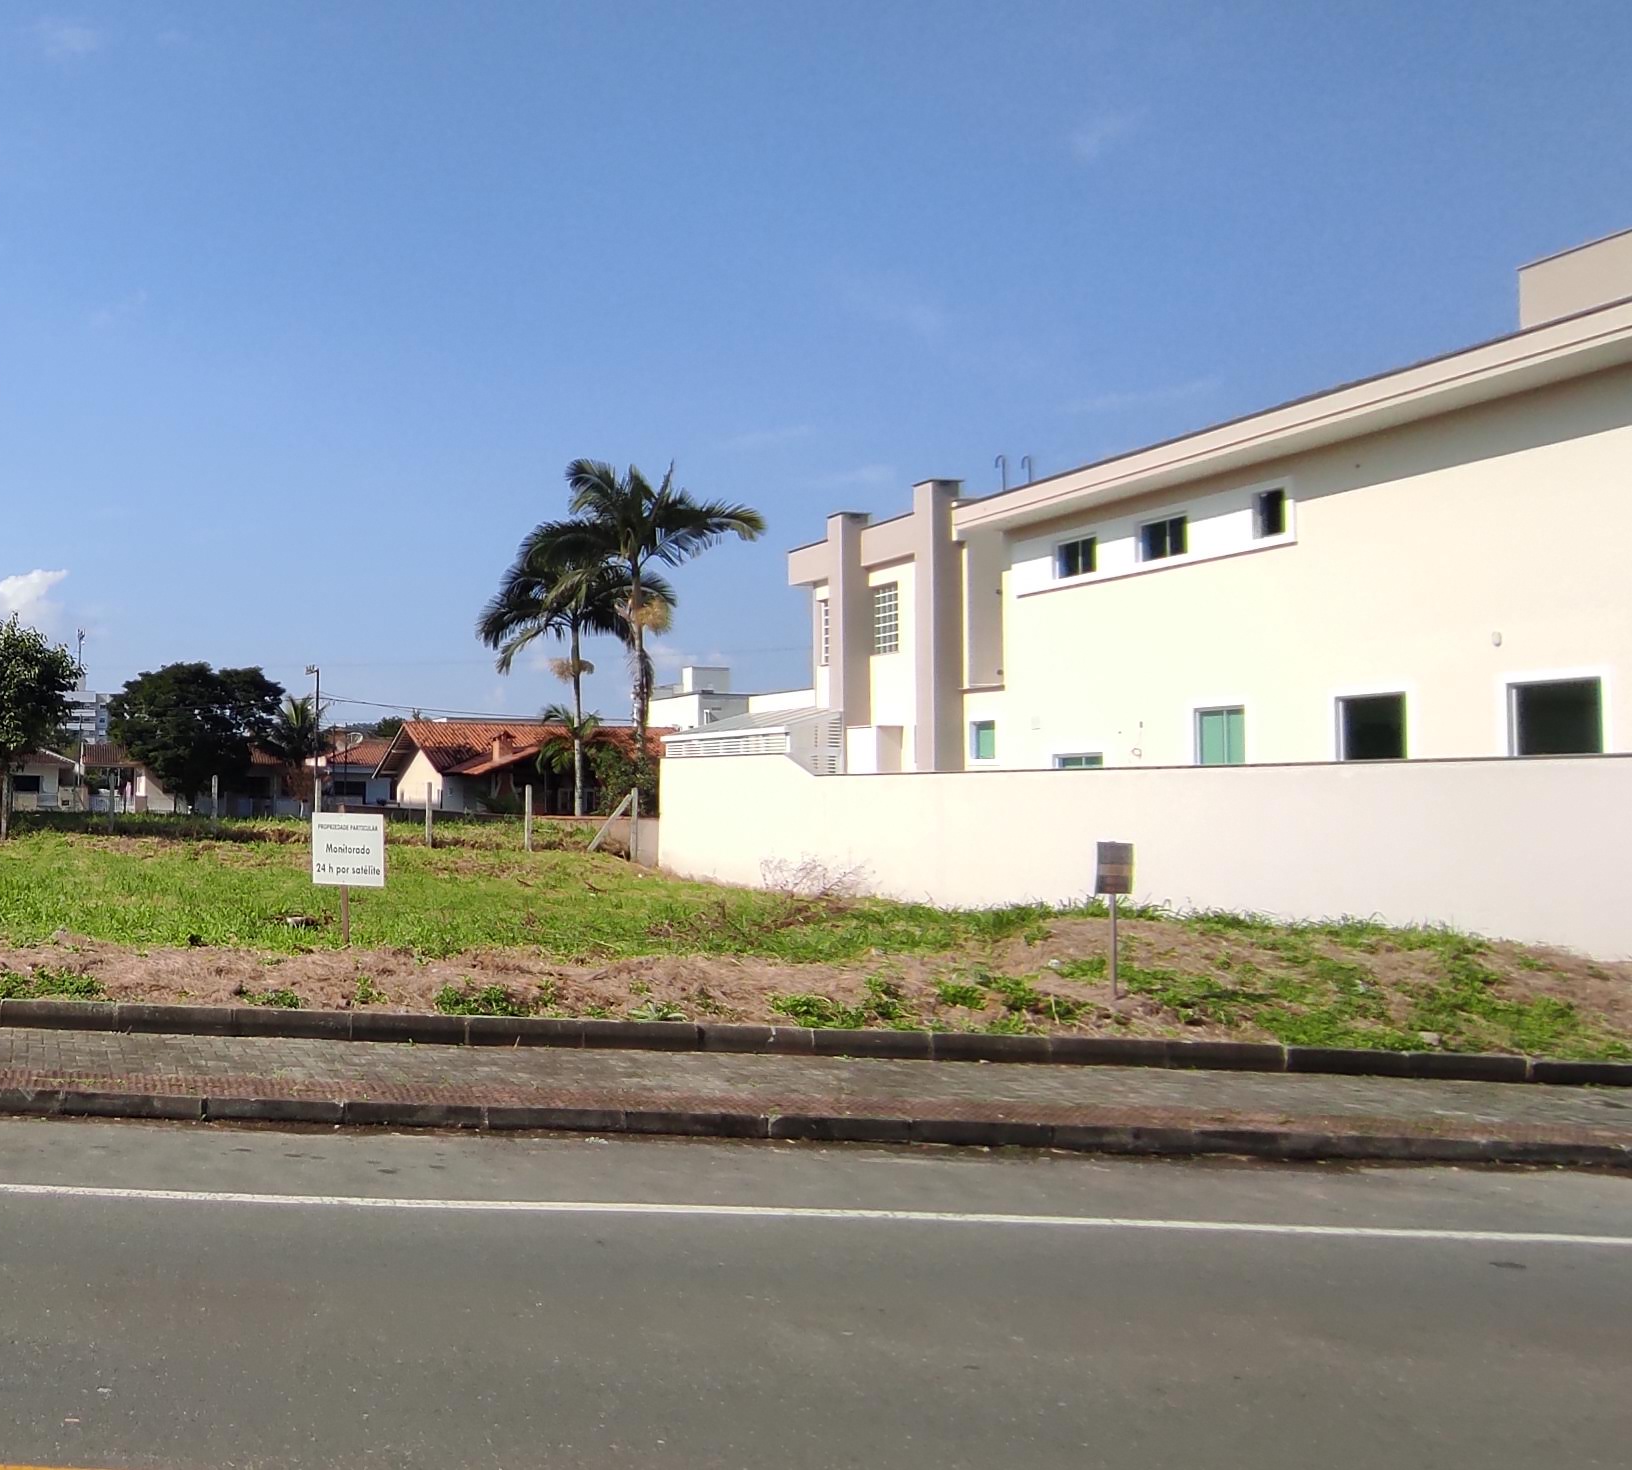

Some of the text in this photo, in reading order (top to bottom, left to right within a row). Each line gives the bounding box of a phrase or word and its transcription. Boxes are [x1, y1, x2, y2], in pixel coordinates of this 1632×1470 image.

[317, 823, 349, 831] PROPRIEDADE
[325, 843, 371, 855] Monitorado
[316, 863, 381, 876] 24 h por satélite
